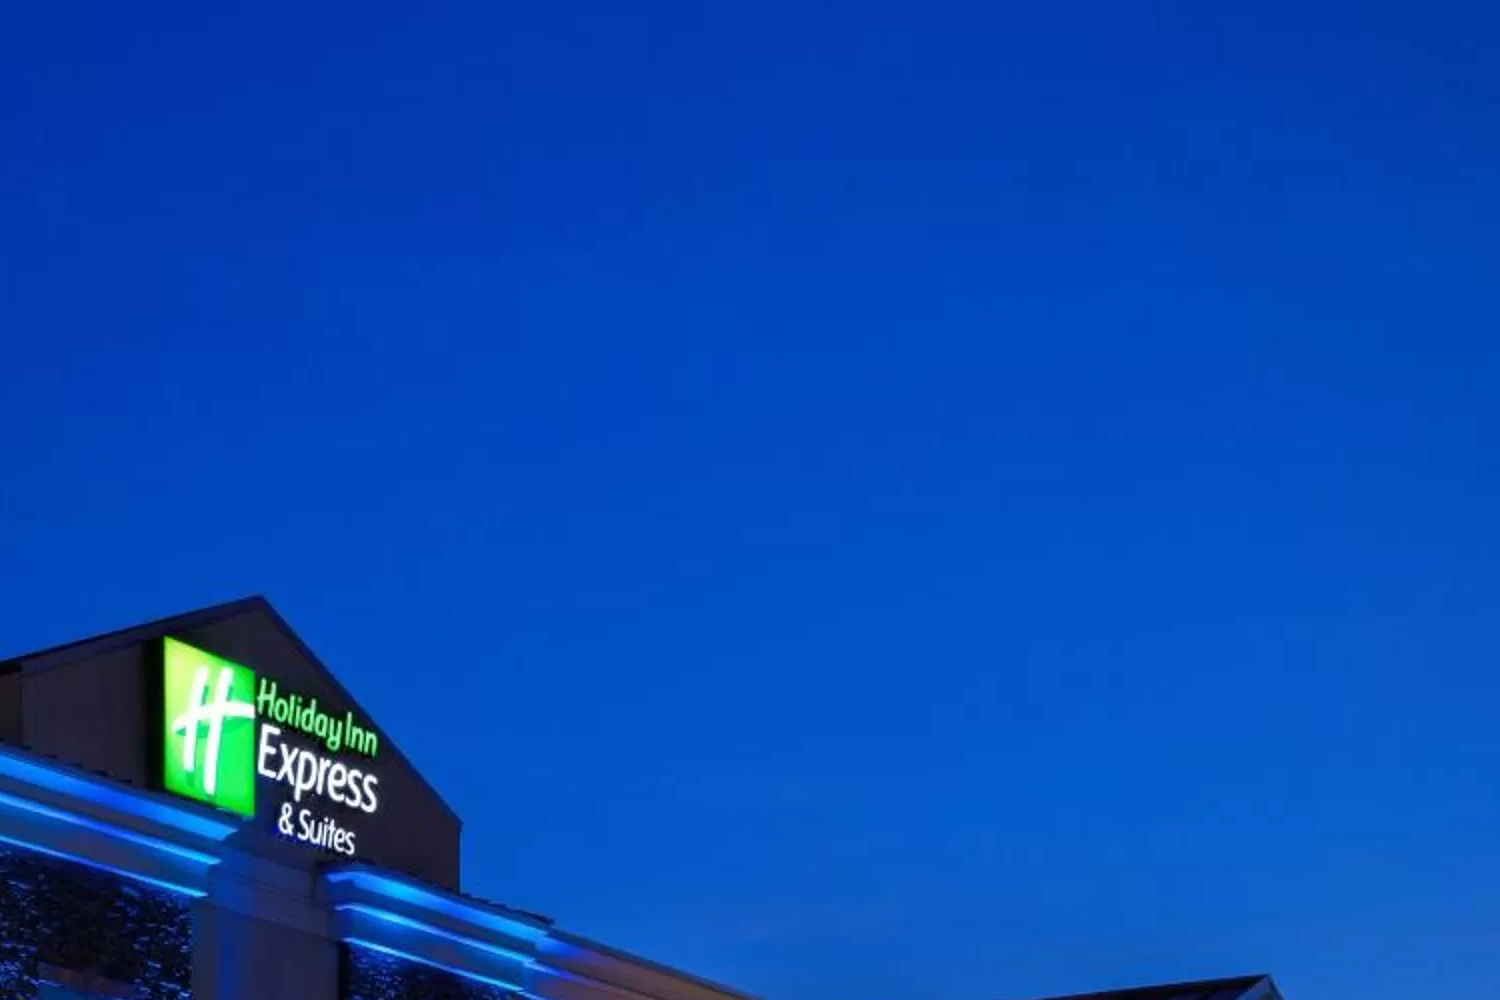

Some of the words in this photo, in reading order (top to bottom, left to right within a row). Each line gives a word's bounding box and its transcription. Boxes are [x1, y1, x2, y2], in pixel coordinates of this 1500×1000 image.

[257, 677, 344, 750] Holiday
[345, 712, 378, 756] Inn
[257, 724, 378, 813] Express
[277, 803, 295, 835] &
[297, 809, 356, 855] Suites
